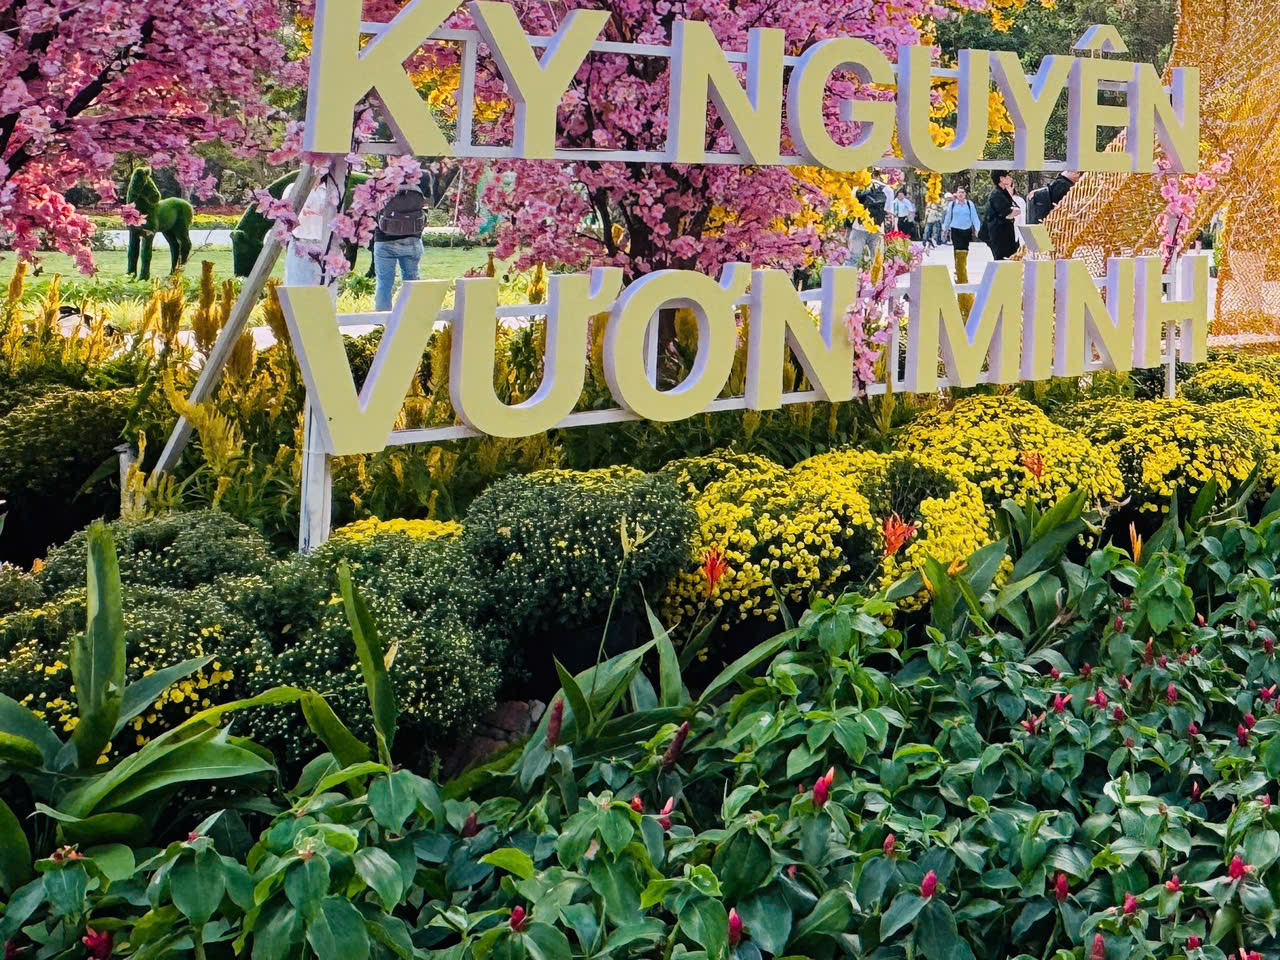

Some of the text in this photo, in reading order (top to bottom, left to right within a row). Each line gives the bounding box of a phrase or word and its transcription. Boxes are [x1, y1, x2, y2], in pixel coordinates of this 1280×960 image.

[672, 19, 1200, 174] NGUYÊN
[277, 224, 1209, 456] VƯƠN MÌNH
